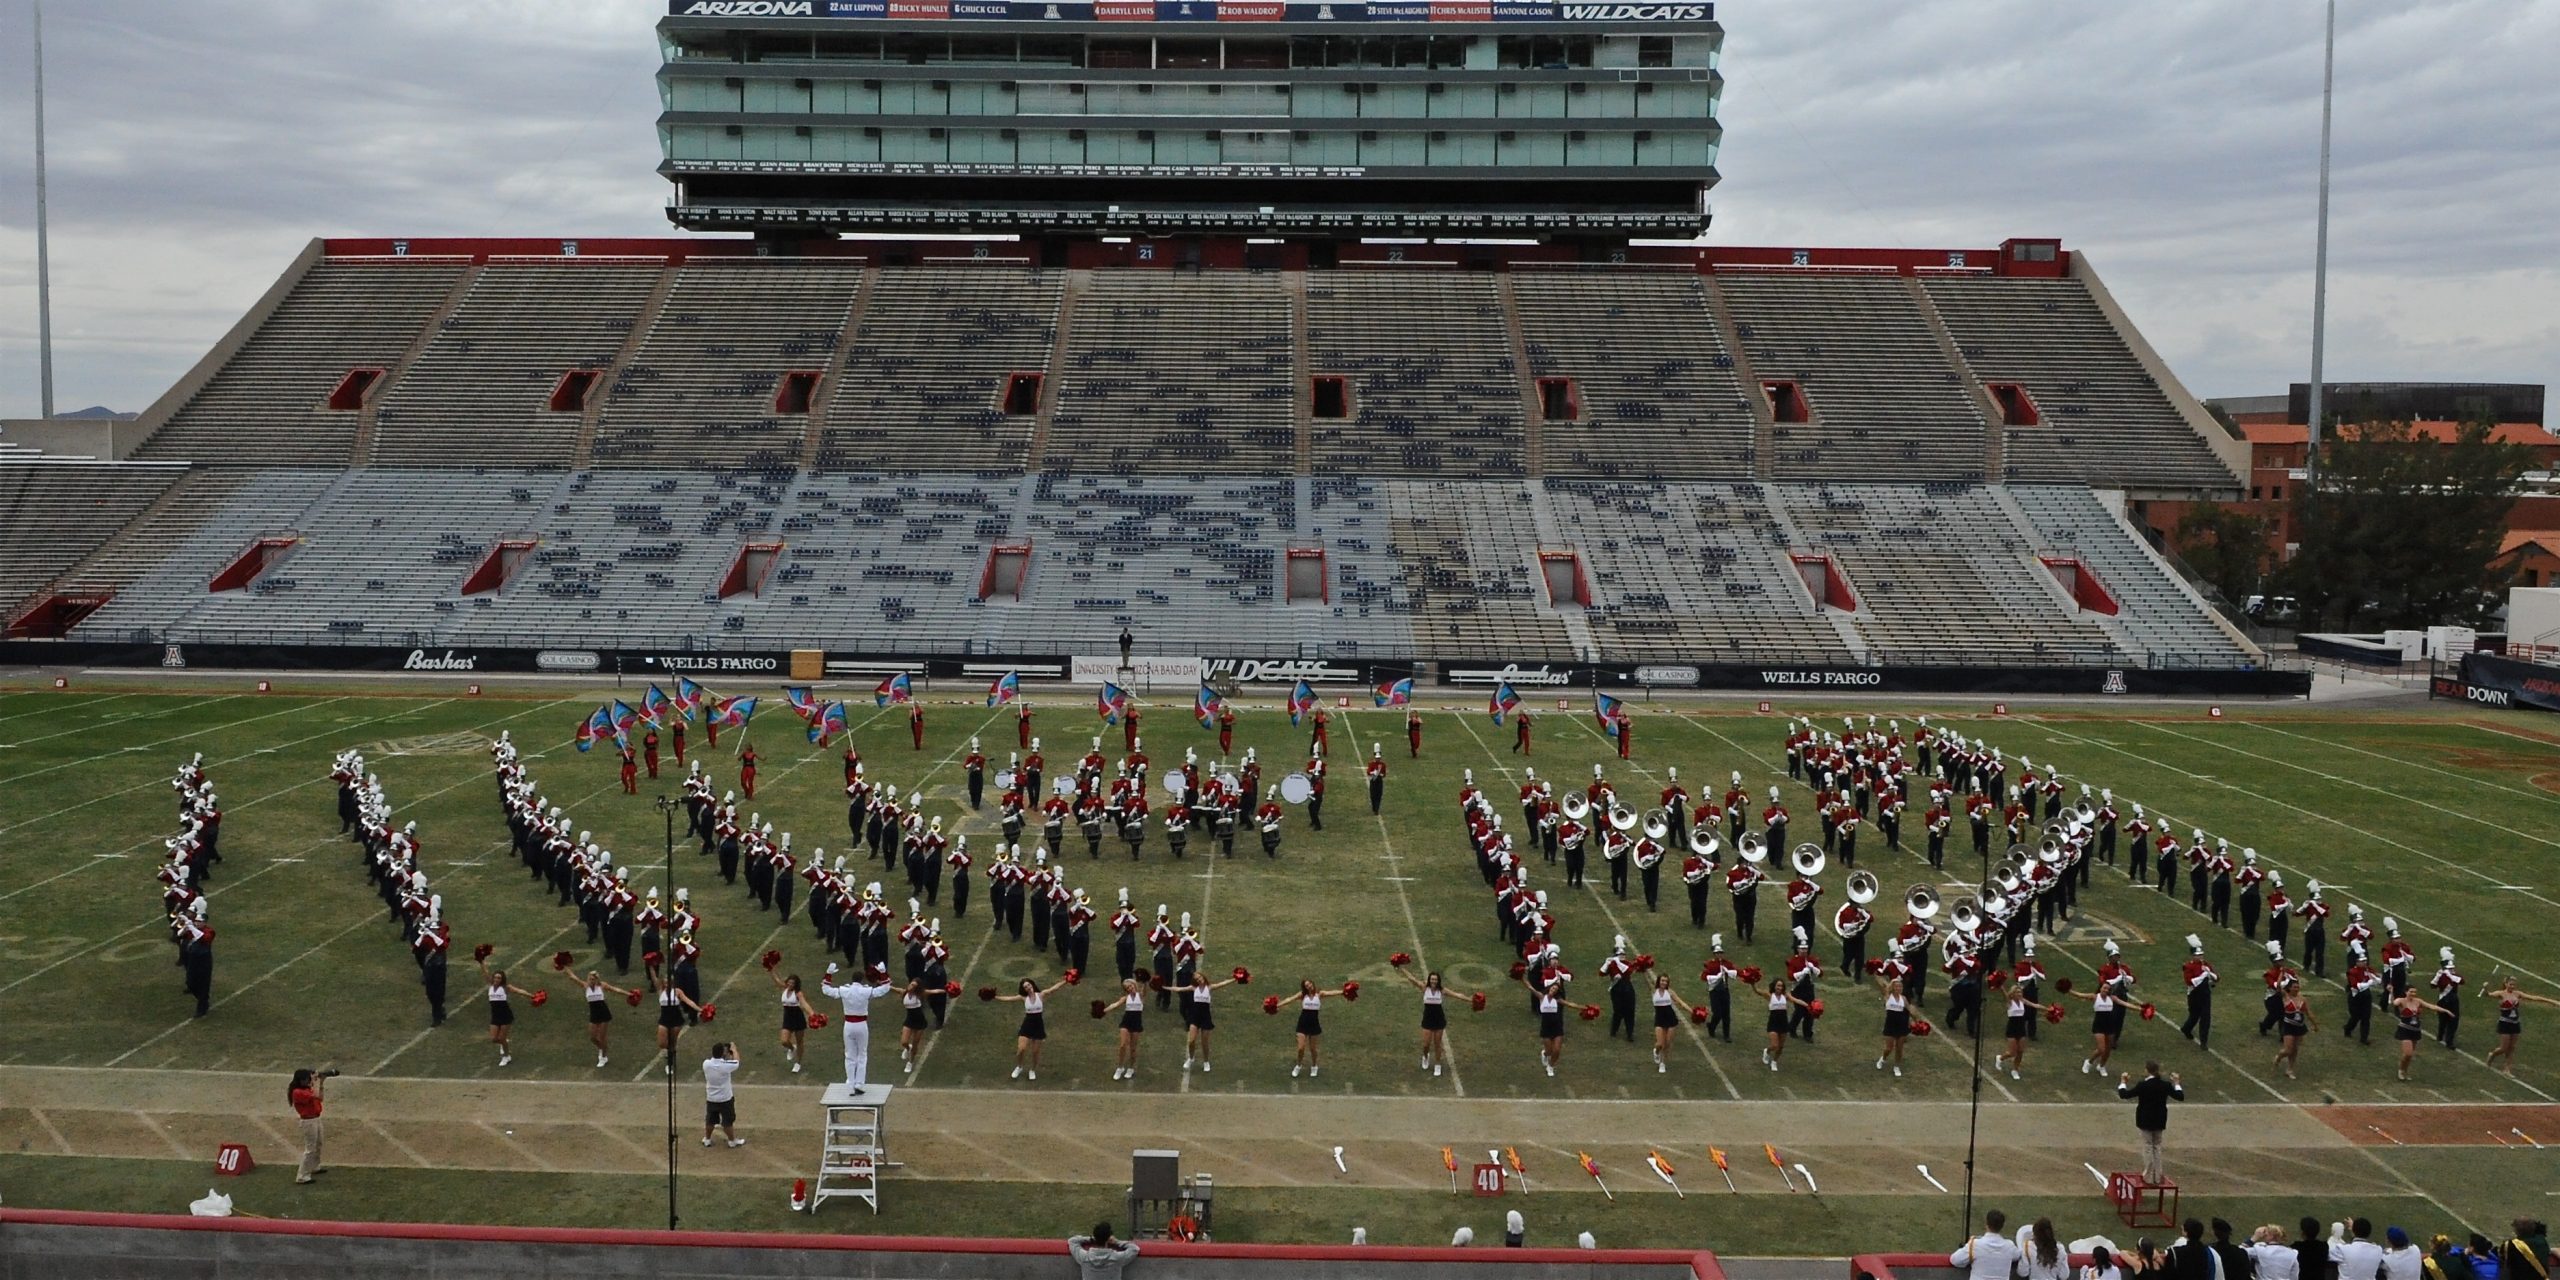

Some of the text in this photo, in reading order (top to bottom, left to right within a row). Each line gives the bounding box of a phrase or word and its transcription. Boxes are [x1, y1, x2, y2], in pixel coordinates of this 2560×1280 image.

[684, 1, 812, 16] ARIZONA
[830, 3, 884, 12] 22 ART LUPPINO
[987, 6, 1006, 14] CECIL
[1228, 7, 1242, 15] ROB
[1244, 7, 1278, 15] WALDROP
[1377, 7, 1393, 15] STEVE
[1394, 7, 1429, 15] McLAUGHLIN
[1436, 7, 1456, 15] CHRIS
[1458, 7, 1491, 15] McALISTER
[1562, 5, 1705, 20] WILDCATS
[394, 246, 406, 255] 17
[564, 246, 575, 256] 18
[757, 247, 768, 257] 19
[974, 248, 988, 257] 20
[1140, 249, 1152, 259] 21
[1389, 252, 1403, 261] 22
[1611, 254, 1626, 263] 23
[1793, 256, 1808, 266] 24
[1949, 258, 1964, 267] 25
[404, 649, 477, 670] Bashas'
[543, 656, 557, 664] SOL
[660, 657, 776, 670] WELLS FARGO
[1075, 664, 1115, 675] UNIVERSITY
[1161, 664, 1182, 675] BAND
[1183, 665, 1197, 676] DAY
[1762, 672, 1880, 685] WELLS FARGO
[2436, 681, 2508, 705] BEAR DOWN
[218, 1148, 240, 1172] 40
[1478, 1169, 1499, 1191] 40
